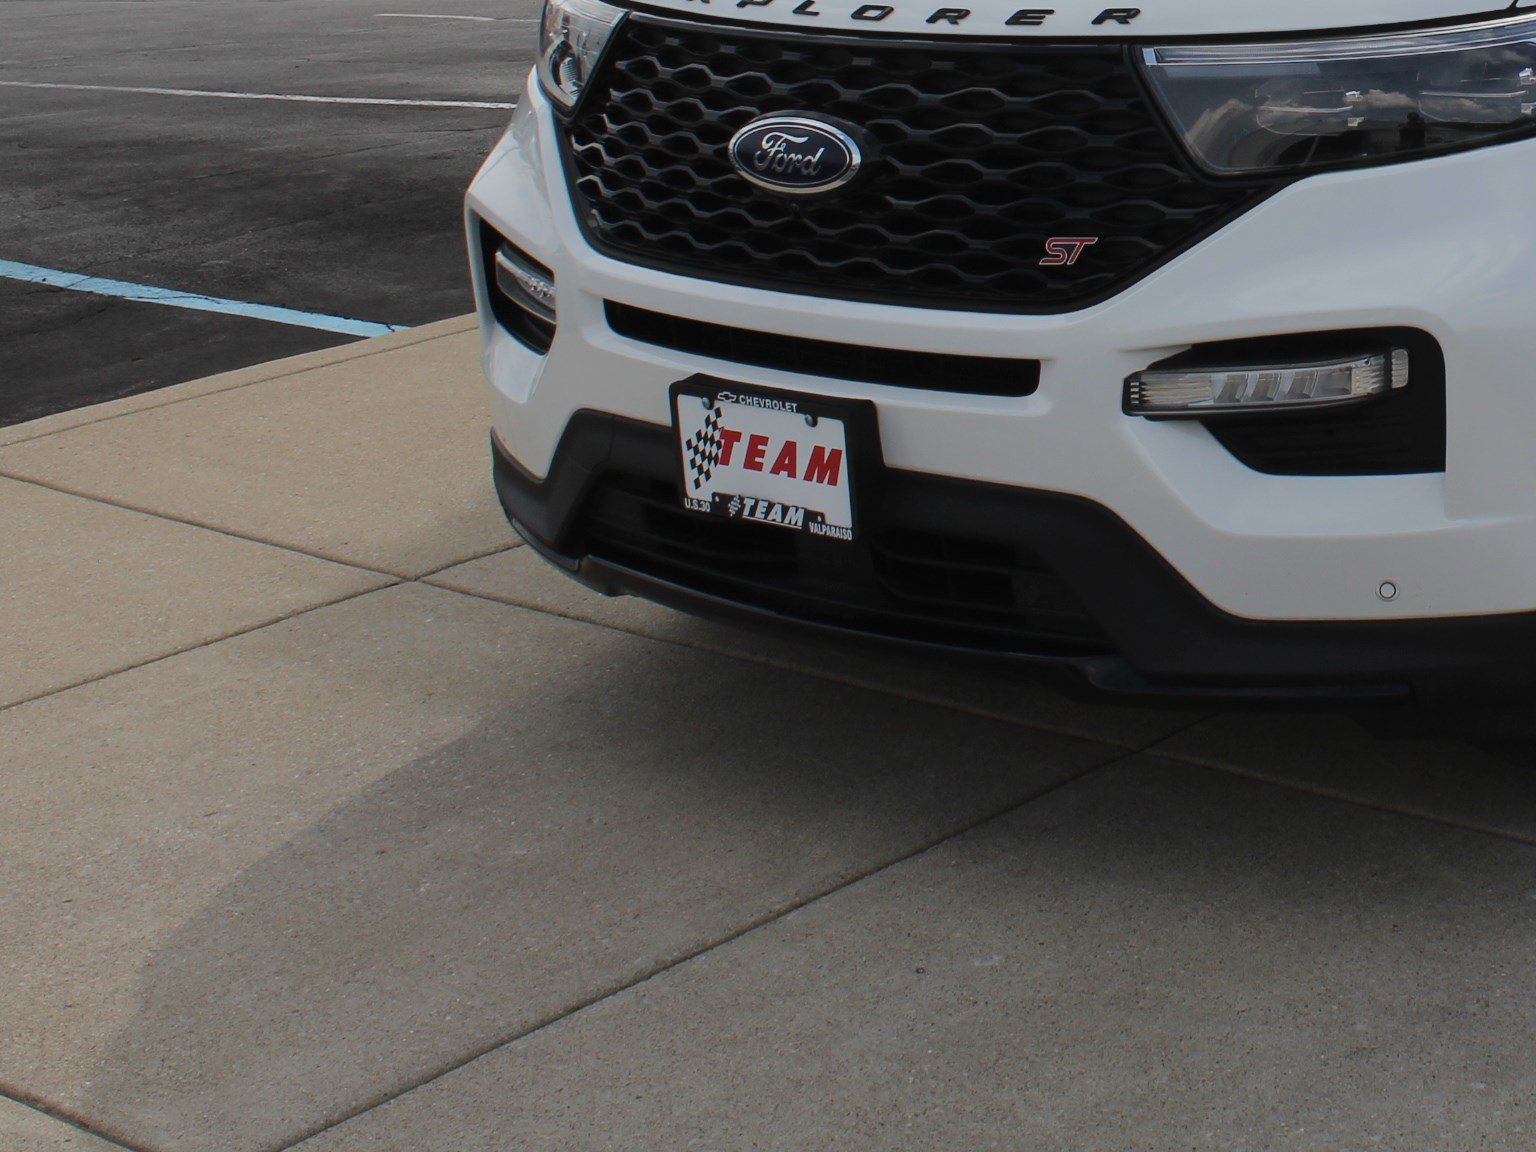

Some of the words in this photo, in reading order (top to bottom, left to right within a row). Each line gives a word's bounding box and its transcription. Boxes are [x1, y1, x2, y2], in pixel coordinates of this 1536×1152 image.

[753, 132, 825, 175] Ford
[1039, 237, 1098, 265] ST
[739, 395, 797, 412] CHEVROLET
[719, 429, 843, 486] TEAM
[742, 498, 804, 527] TEAM
[809, 522, 853, 540] VALPARAISO
